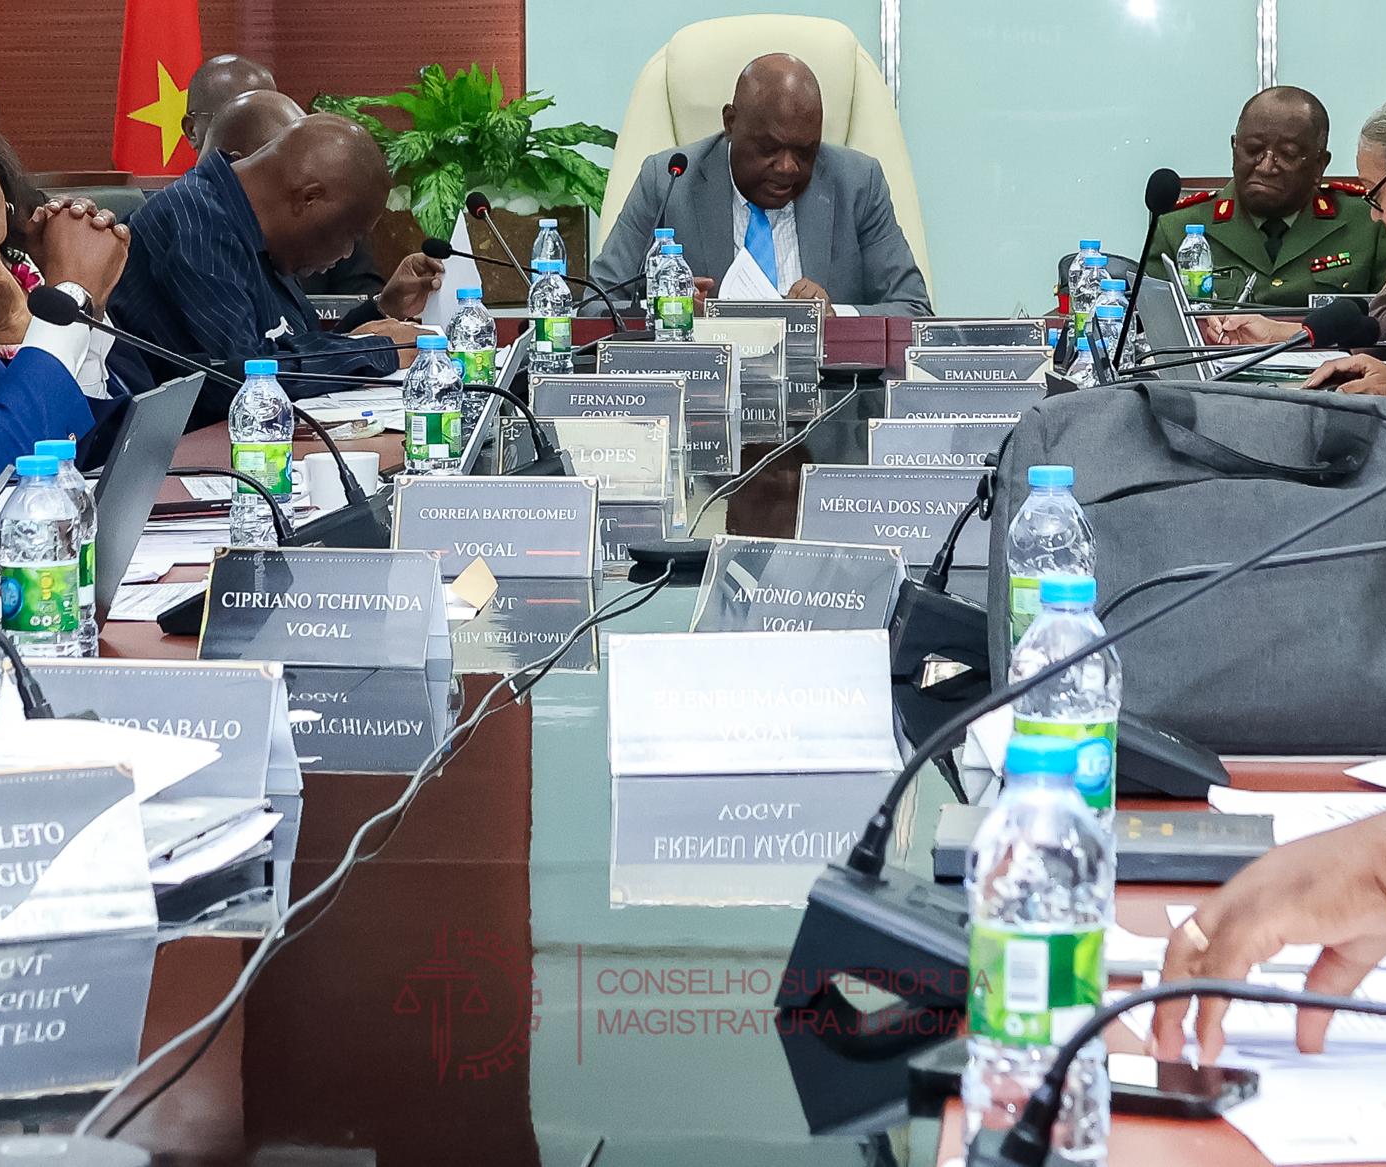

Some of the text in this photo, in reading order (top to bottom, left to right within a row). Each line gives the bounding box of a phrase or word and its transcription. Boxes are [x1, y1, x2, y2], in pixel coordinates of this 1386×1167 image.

[786, 323, 817, 333] LDES
[945, 370, 1018, 381] EMANUELA
[569, 394, 646, 406] FERNANDO
[579, 448, 637, 463] LOPES
[883, 453, 964, 466] GRACIANO
[819, 495, 884, 513] MÉRCIA
[888, 500, 921, 514] DOS
[419, 508, 577, 521] CORREIA BARTOLOMEU
[873, 524, 932, 539] VOGAL
[454, 542, 518, 557] VOGAL
[221, 591, 423, 612] CIPRIANO TCHIVINDA
[732, 584, 866, 611] ANTÓNIO MOISÉS
[286, 622, 352, 639] VOGAL
[653, 683, 868, 711] ERENEU MÁQUINA
[146, 718, 242, 740] SABALO
[718, 721, 800, 742] VOGAL
